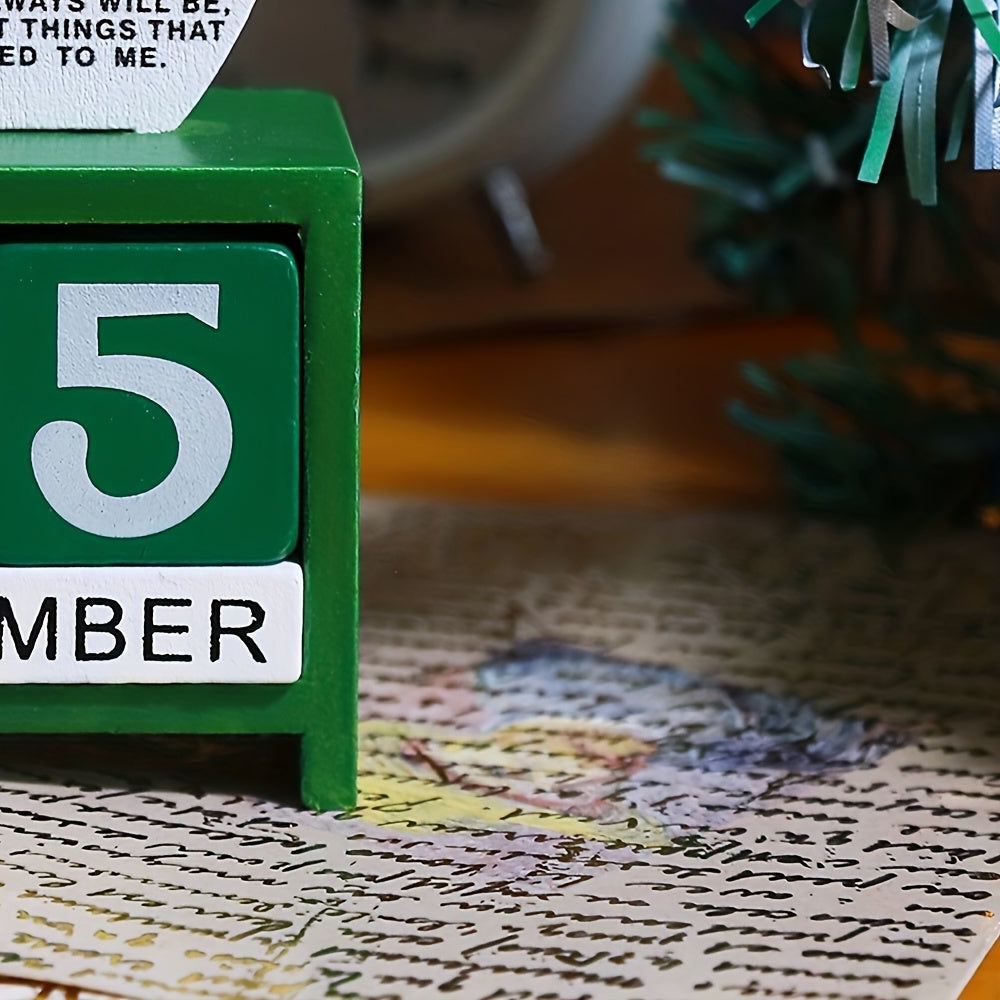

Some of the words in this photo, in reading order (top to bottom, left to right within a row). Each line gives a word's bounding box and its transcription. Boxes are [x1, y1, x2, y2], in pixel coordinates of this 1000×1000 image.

[20, 18, 137, 40] THINGS
[148, 19, 225, 41] THAT
[57, 46, 96, 67] TO
[115, 47, 167, 69] ME.
